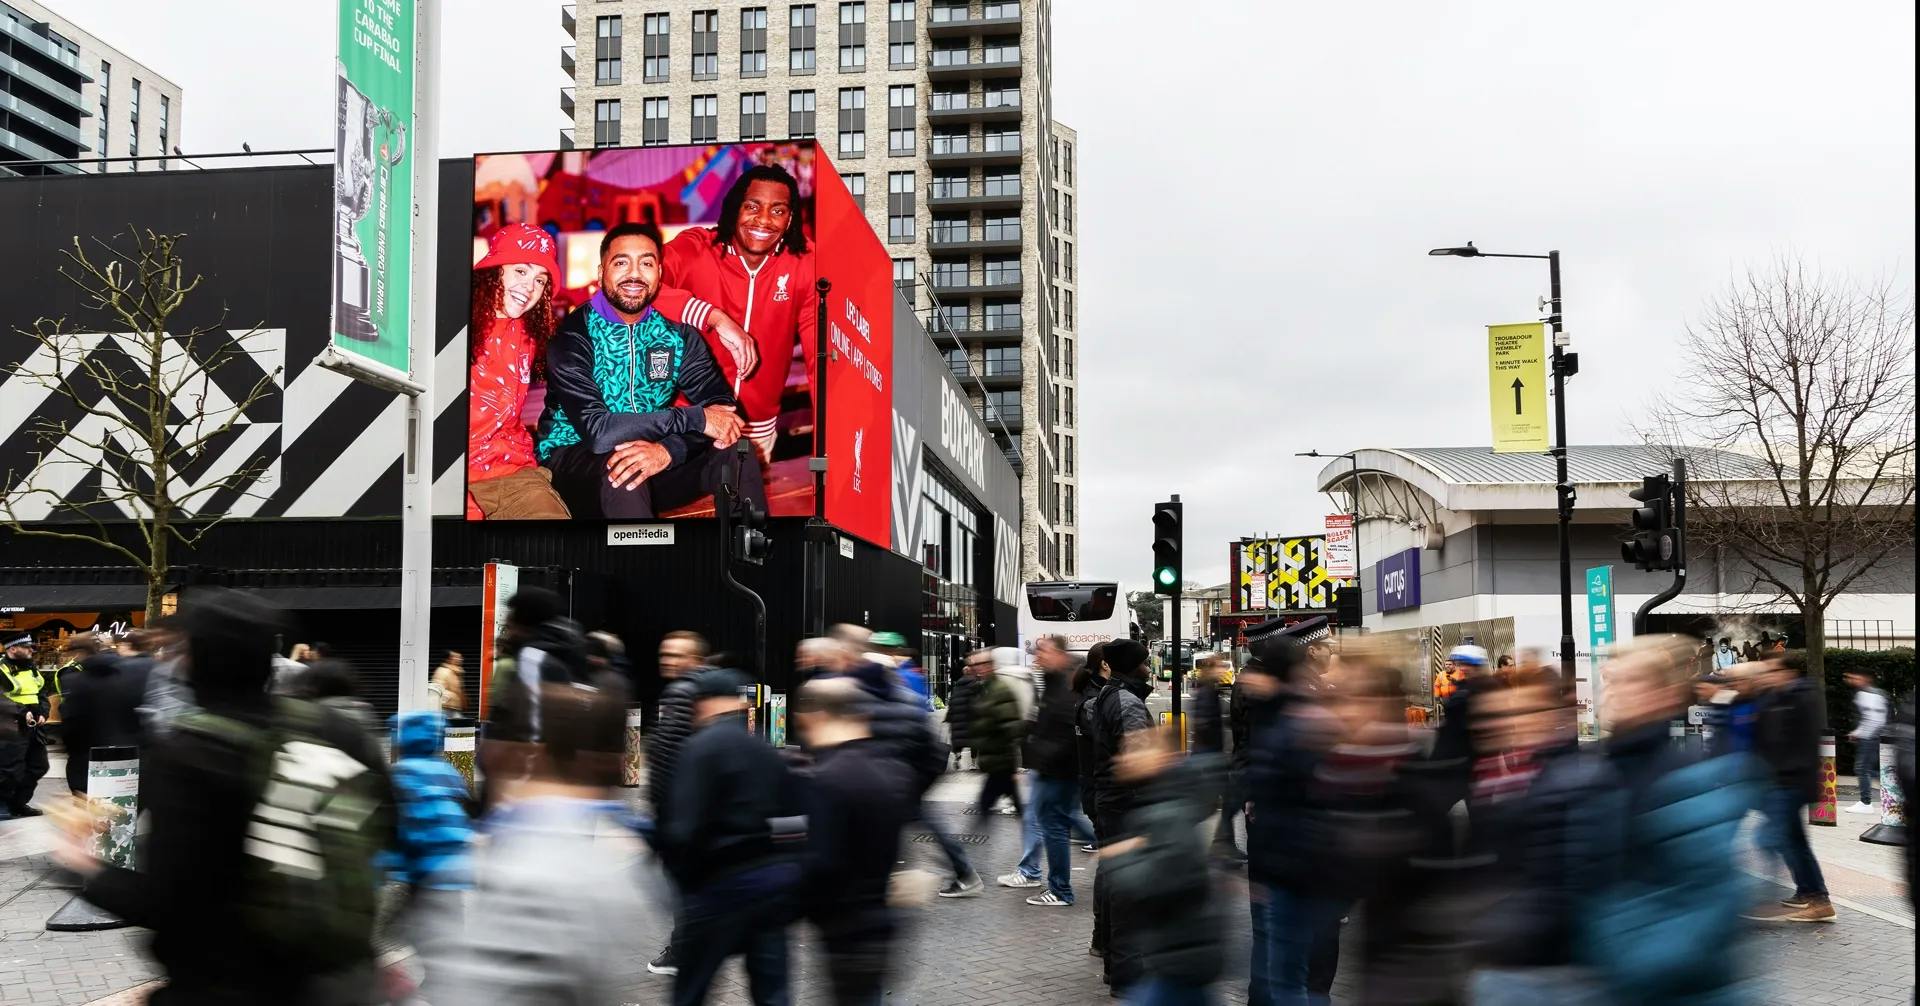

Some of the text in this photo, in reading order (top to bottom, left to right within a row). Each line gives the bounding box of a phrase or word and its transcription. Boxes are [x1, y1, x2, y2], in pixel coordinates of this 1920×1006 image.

[355, 8, 400, 53] CARABAO
[376, 4, 394, 31] THE
[354, 26, 402, 74] CUP FINAL
[377, 230, 386, 280] ENERGY
[376, 279, 385, 316] DRINK
[846, 297, 871, 345] LFC LABEL
[831, 321, 883, 393] ONLINE APP STORES
[941, 375, 985, 492] BOXPARK
[1384, 569, 1405, 600] currys
